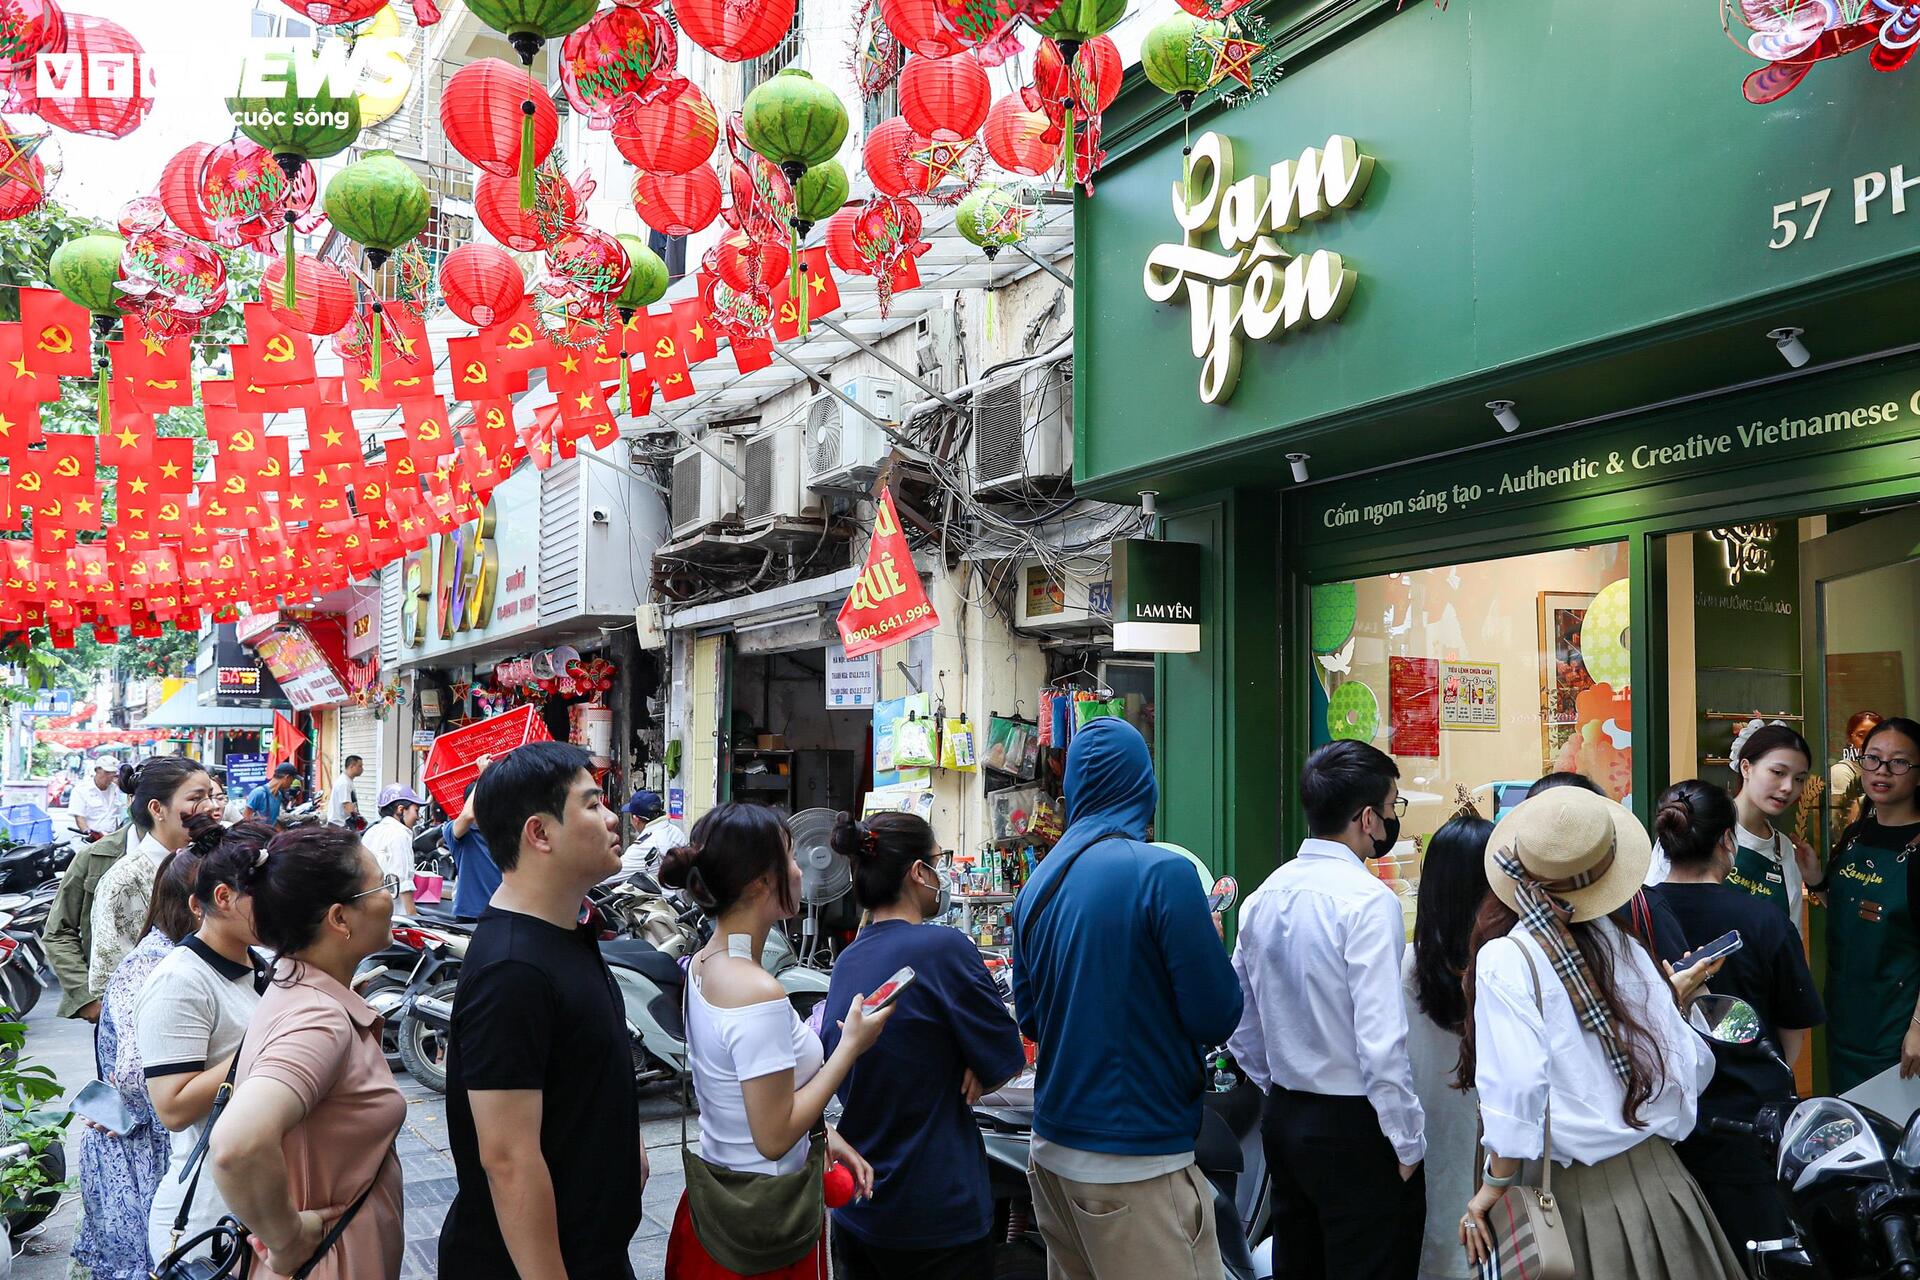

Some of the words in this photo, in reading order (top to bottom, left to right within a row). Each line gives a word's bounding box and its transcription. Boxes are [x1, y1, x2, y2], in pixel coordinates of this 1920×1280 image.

[1143, 131, 1377, 302] Lam
[1768, 187, 1832, 249] 57
[1323, 502, 1359, 528] Cốm
[1363, 500, 1404, 525] ngon
[1408, 489, 1448, 513] sáng
[1452, 484, 1482, 510] tạo
[1499, 457, 1600, 495] Authentic
[1605, 451, 1625, 475] &
[1631, 434, 1732, 469] Creative
[1736, 400, 1900, 448] Vietnamese
[850, 551, 907, 610] QUÊ
[1775, 600, 1792, 615] XÀO
[844, 602, 931, 645] 0904.641.996
[1136, 603, 1165, 619] LAM
[1166, 602, 1193, 620] YÊN
